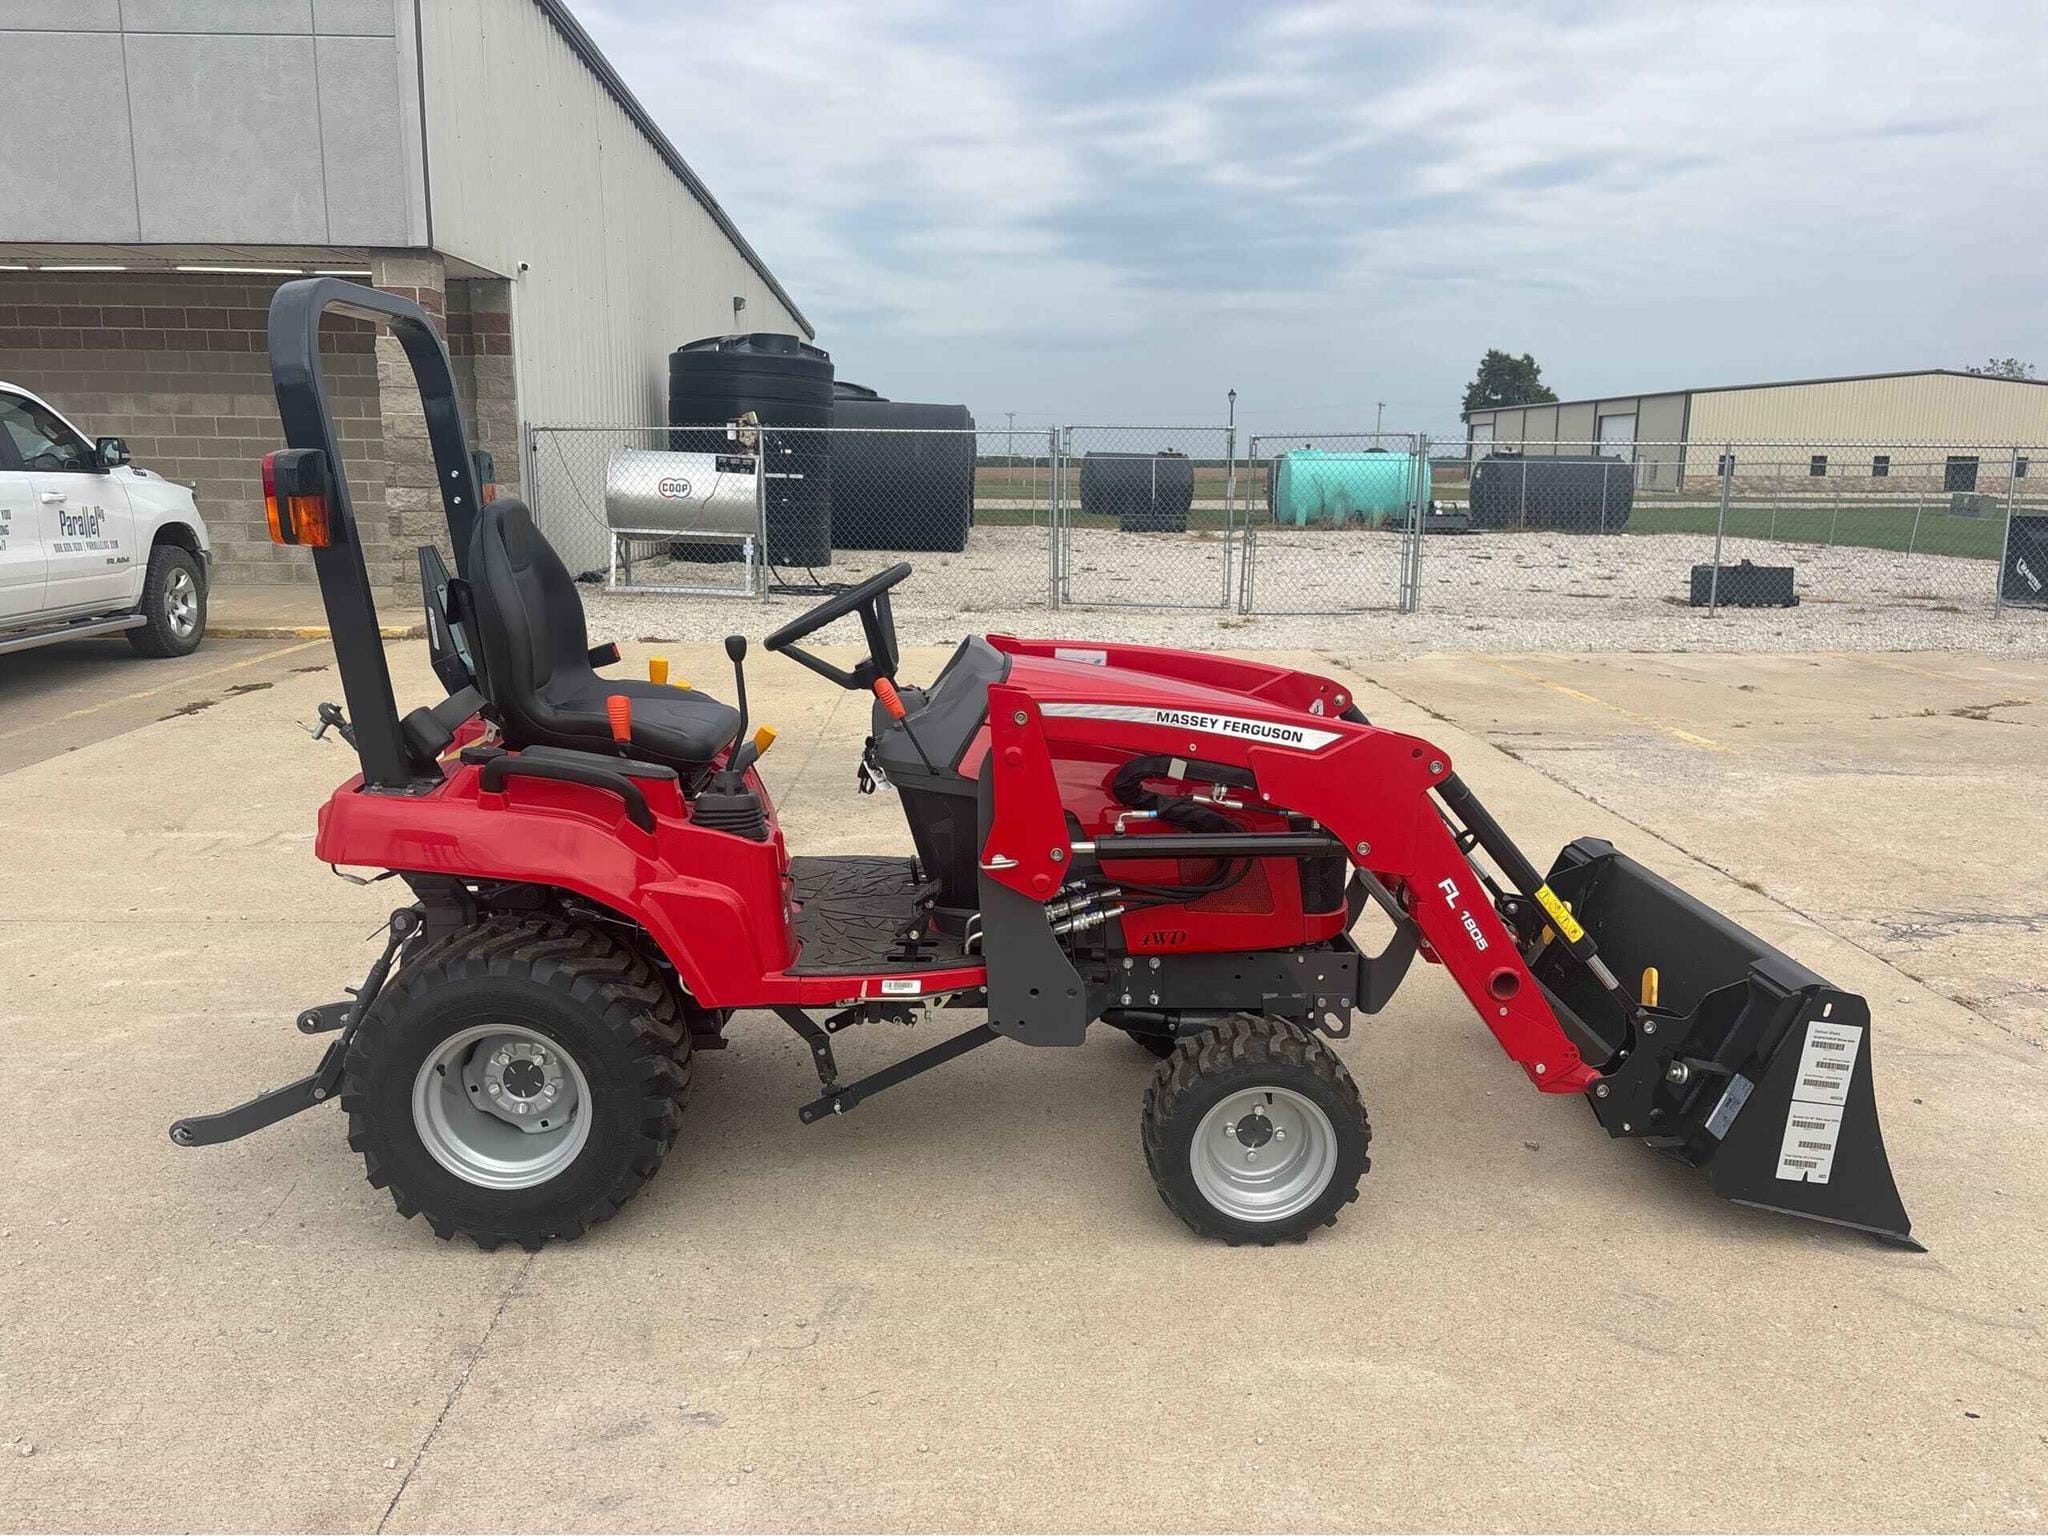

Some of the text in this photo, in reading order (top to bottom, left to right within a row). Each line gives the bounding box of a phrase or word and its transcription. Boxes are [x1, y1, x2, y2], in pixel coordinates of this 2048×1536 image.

[662, 483, 688, 492] COOP
[1156, 711, 1303, 743] MASSEY FERGUSON
[1437, 877, 1489, 951] FL 1805
